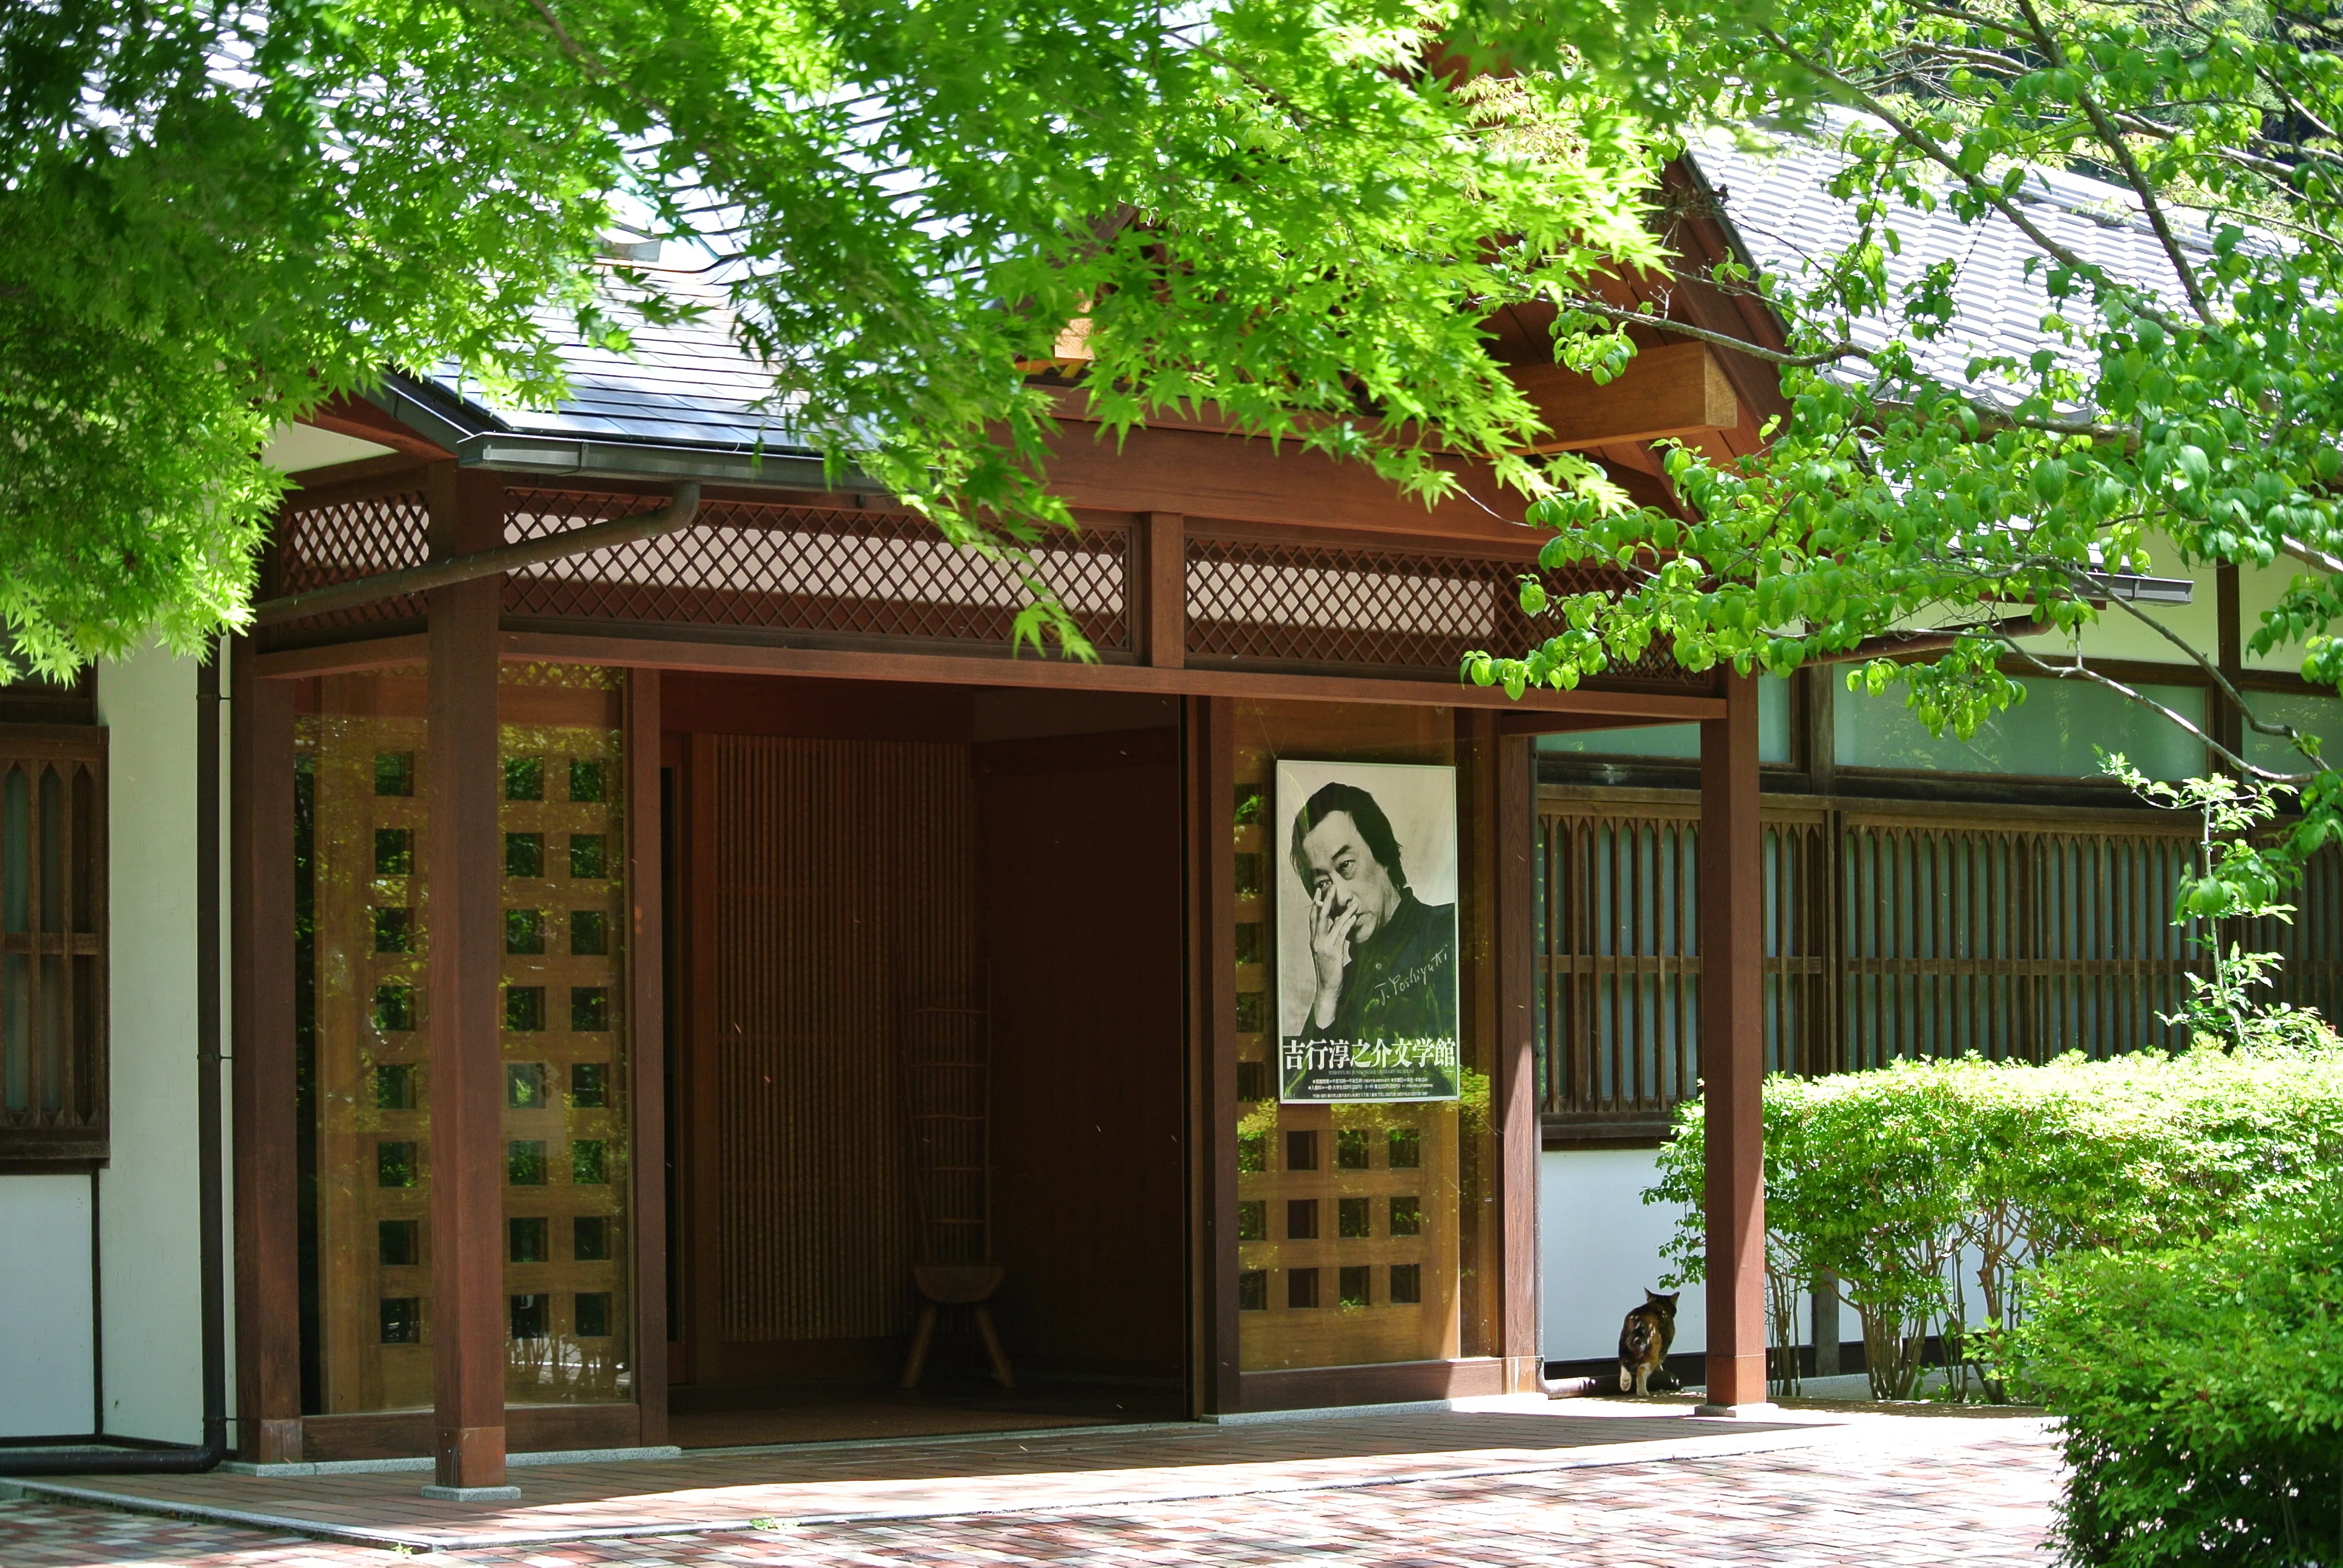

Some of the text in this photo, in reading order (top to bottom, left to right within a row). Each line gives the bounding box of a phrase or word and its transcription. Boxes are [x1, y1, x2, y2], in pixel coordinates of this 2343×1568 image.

[1283, 1037, 1456, 1070] 吉行淳之介文学館
